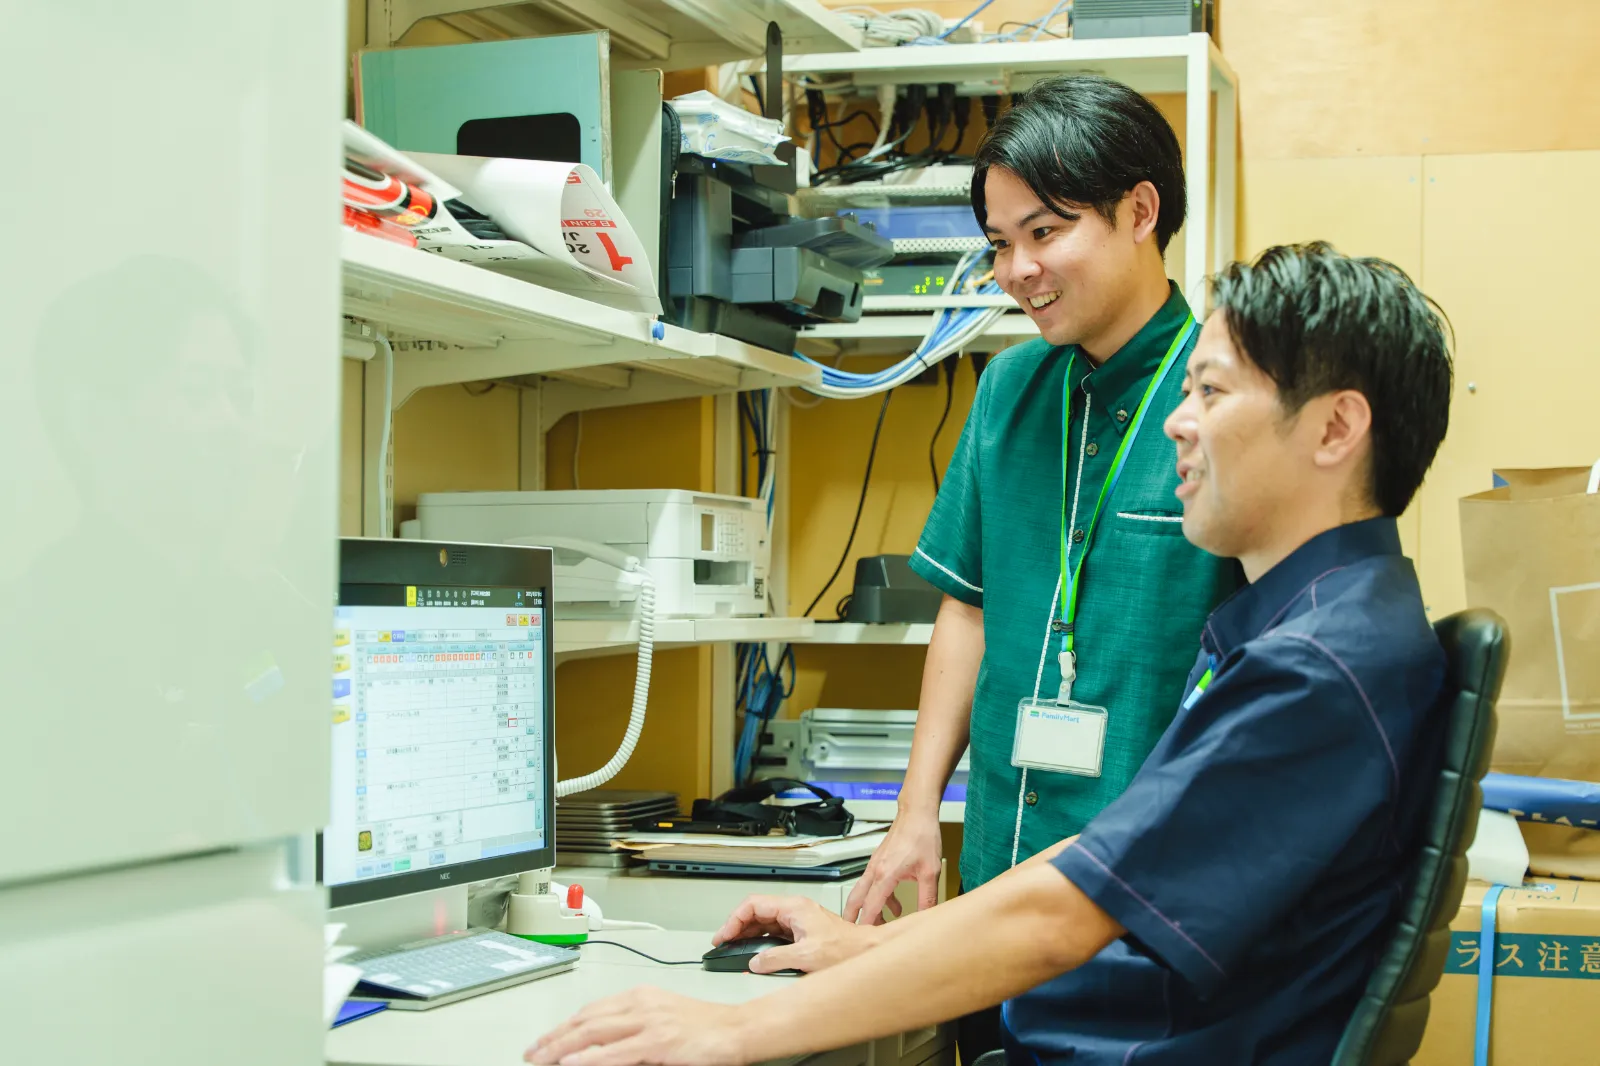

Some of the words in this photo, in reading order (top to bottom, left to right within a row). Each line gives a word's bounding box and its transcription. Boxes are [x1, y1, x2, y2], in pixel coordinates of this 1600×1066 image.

[583, 208, 606, 218] 29
[595, 232, 633, 271] 1
[1041, 711, 1080, 723] FamilyMart
[439, 871, 451, 881] NEC
